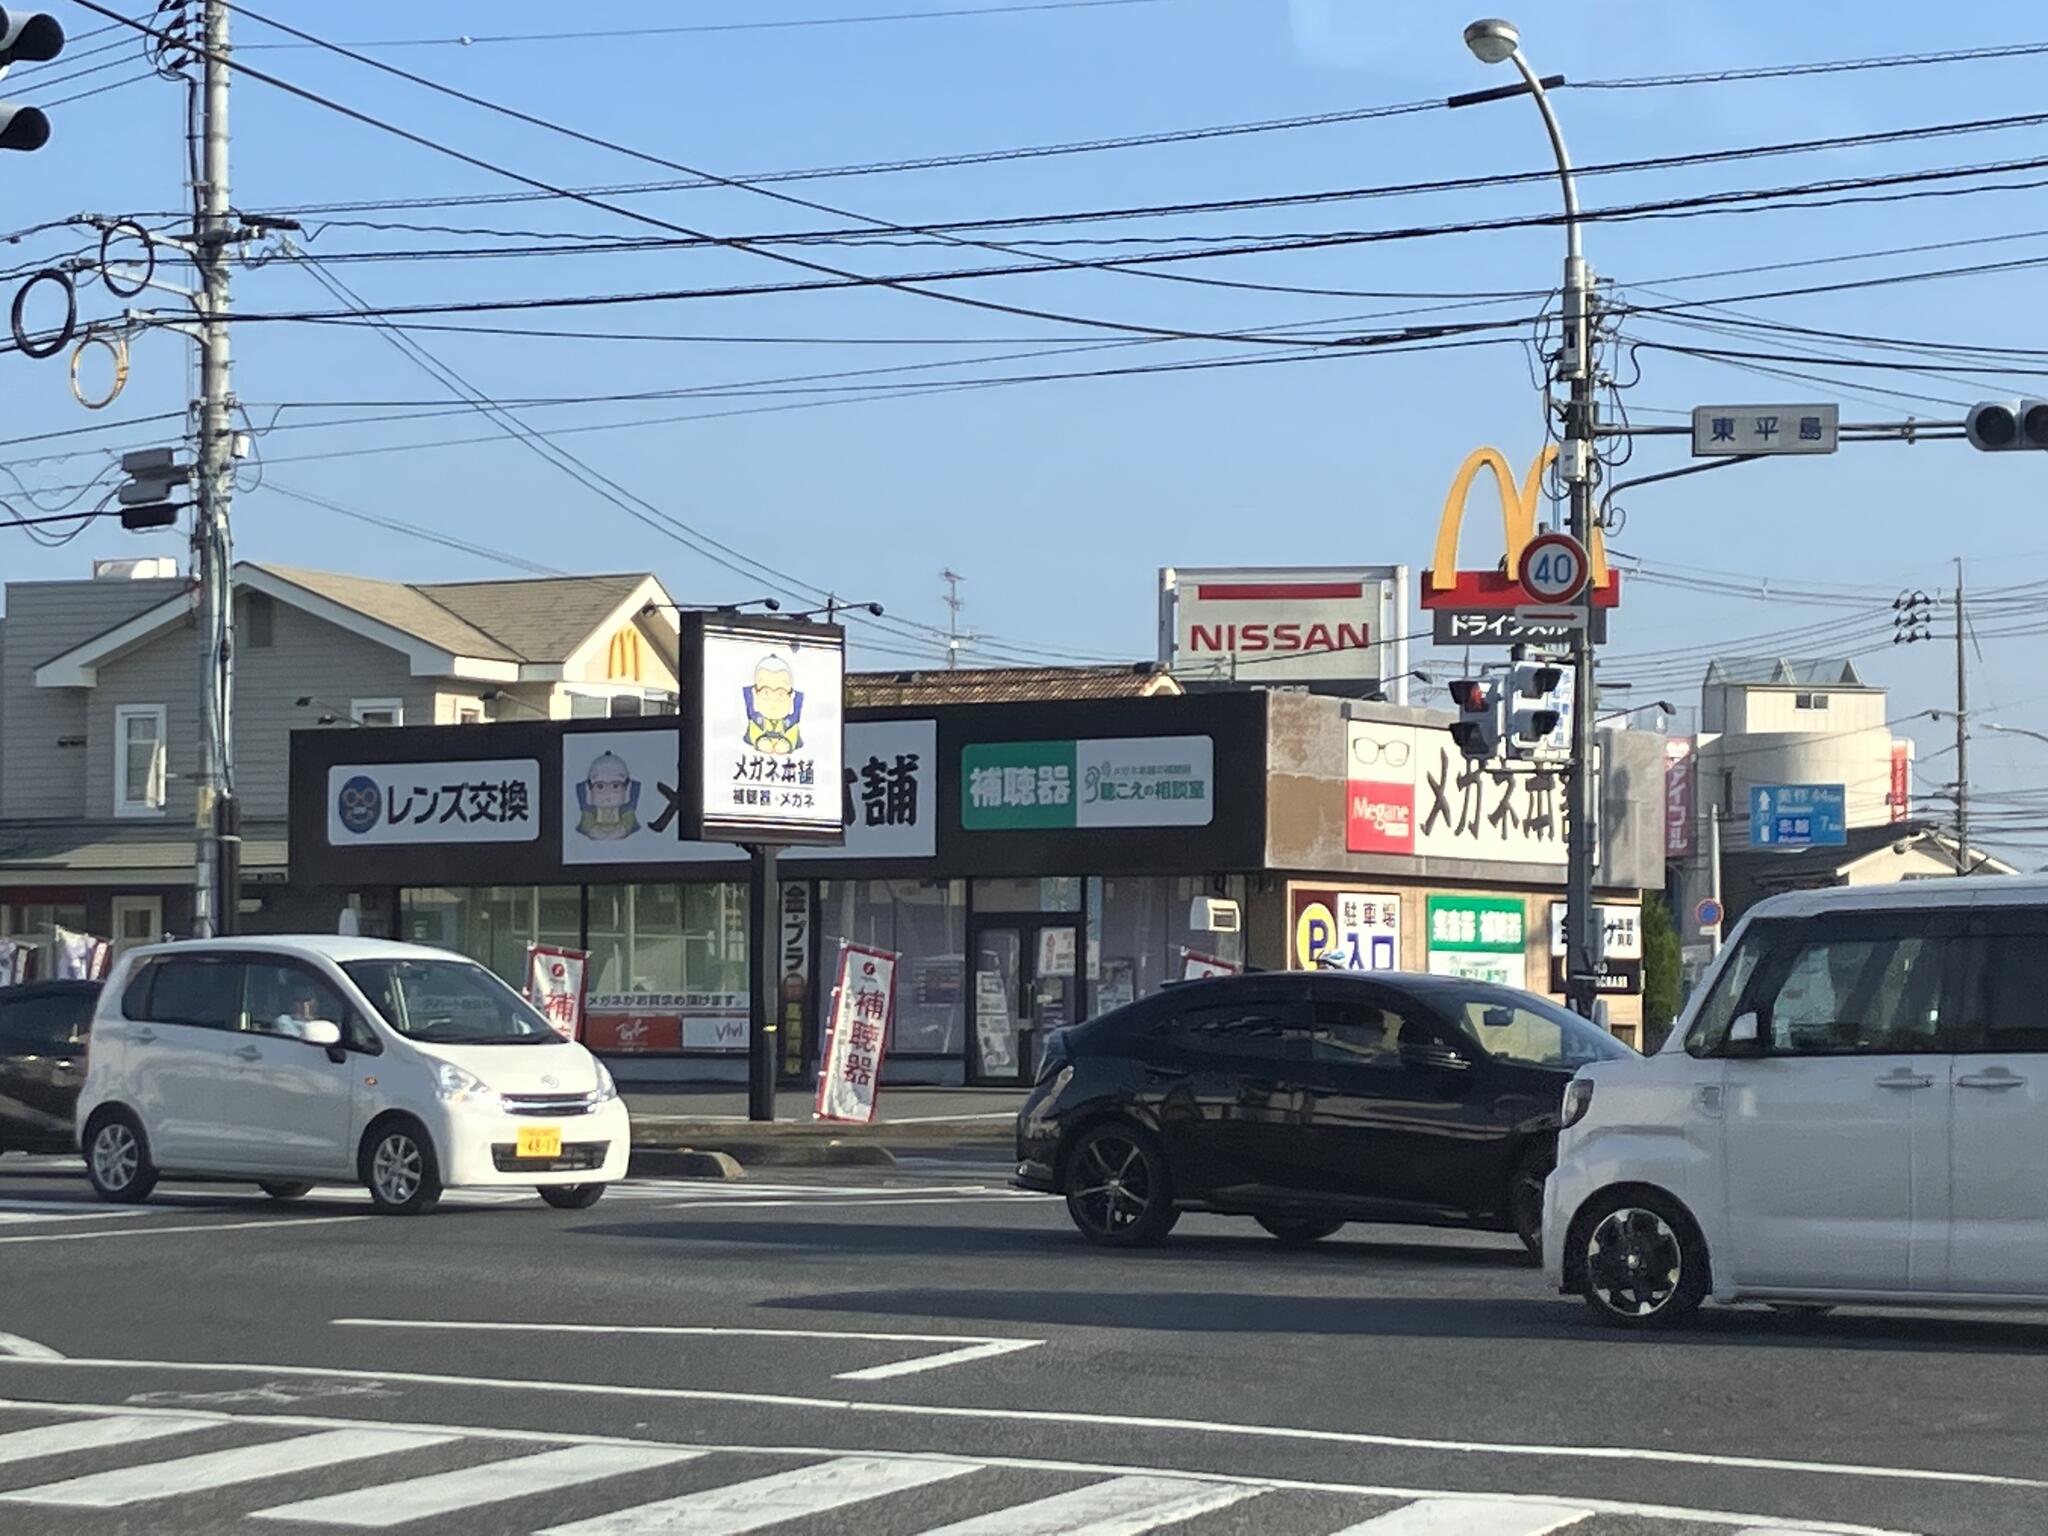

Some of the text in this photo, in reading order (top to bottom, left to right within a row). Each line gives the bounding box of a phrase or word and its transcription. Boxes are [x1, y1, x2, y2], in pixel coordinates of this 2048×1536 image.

[1710, 416, 1823, 442] 東平島
[1533, 553, 1573, 585] 40
[1190, 623, 1370, 652] NISSAN
[387, 779, 530, 826] レンズ交換
[970, 765, 1071, 808] 補聴器
[1352, 795, 1410, 831] Megane
[1347, 931, 1394, 970] 入口
[843, 986, 885, 1086] 補聴器
